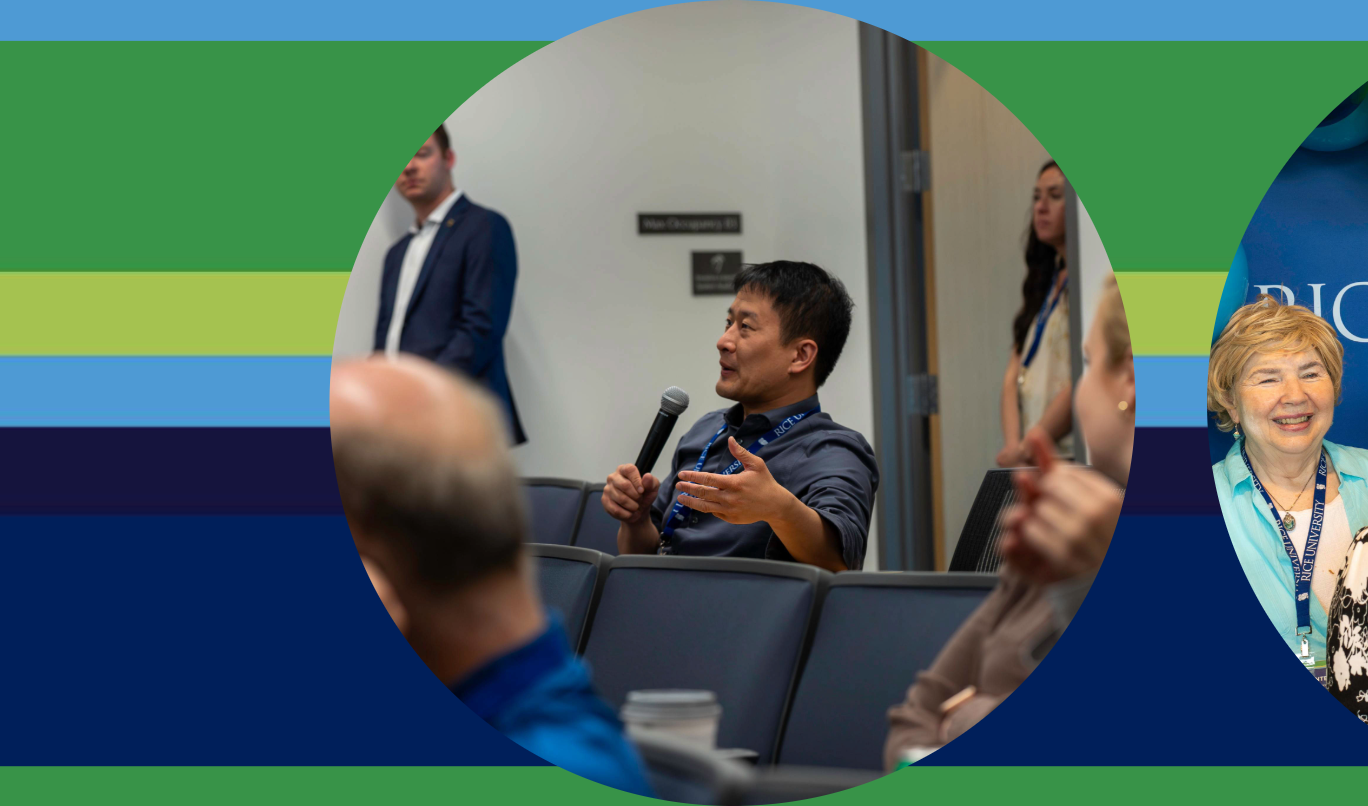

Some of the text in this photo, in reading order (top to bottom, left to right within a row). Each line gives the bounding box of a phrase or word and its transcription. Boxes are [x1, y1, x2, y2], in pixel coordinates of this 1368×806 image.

[774, 416, 796, 437] RICE
[1300, 499, 1326, 582] RICE UNIVERSITY
